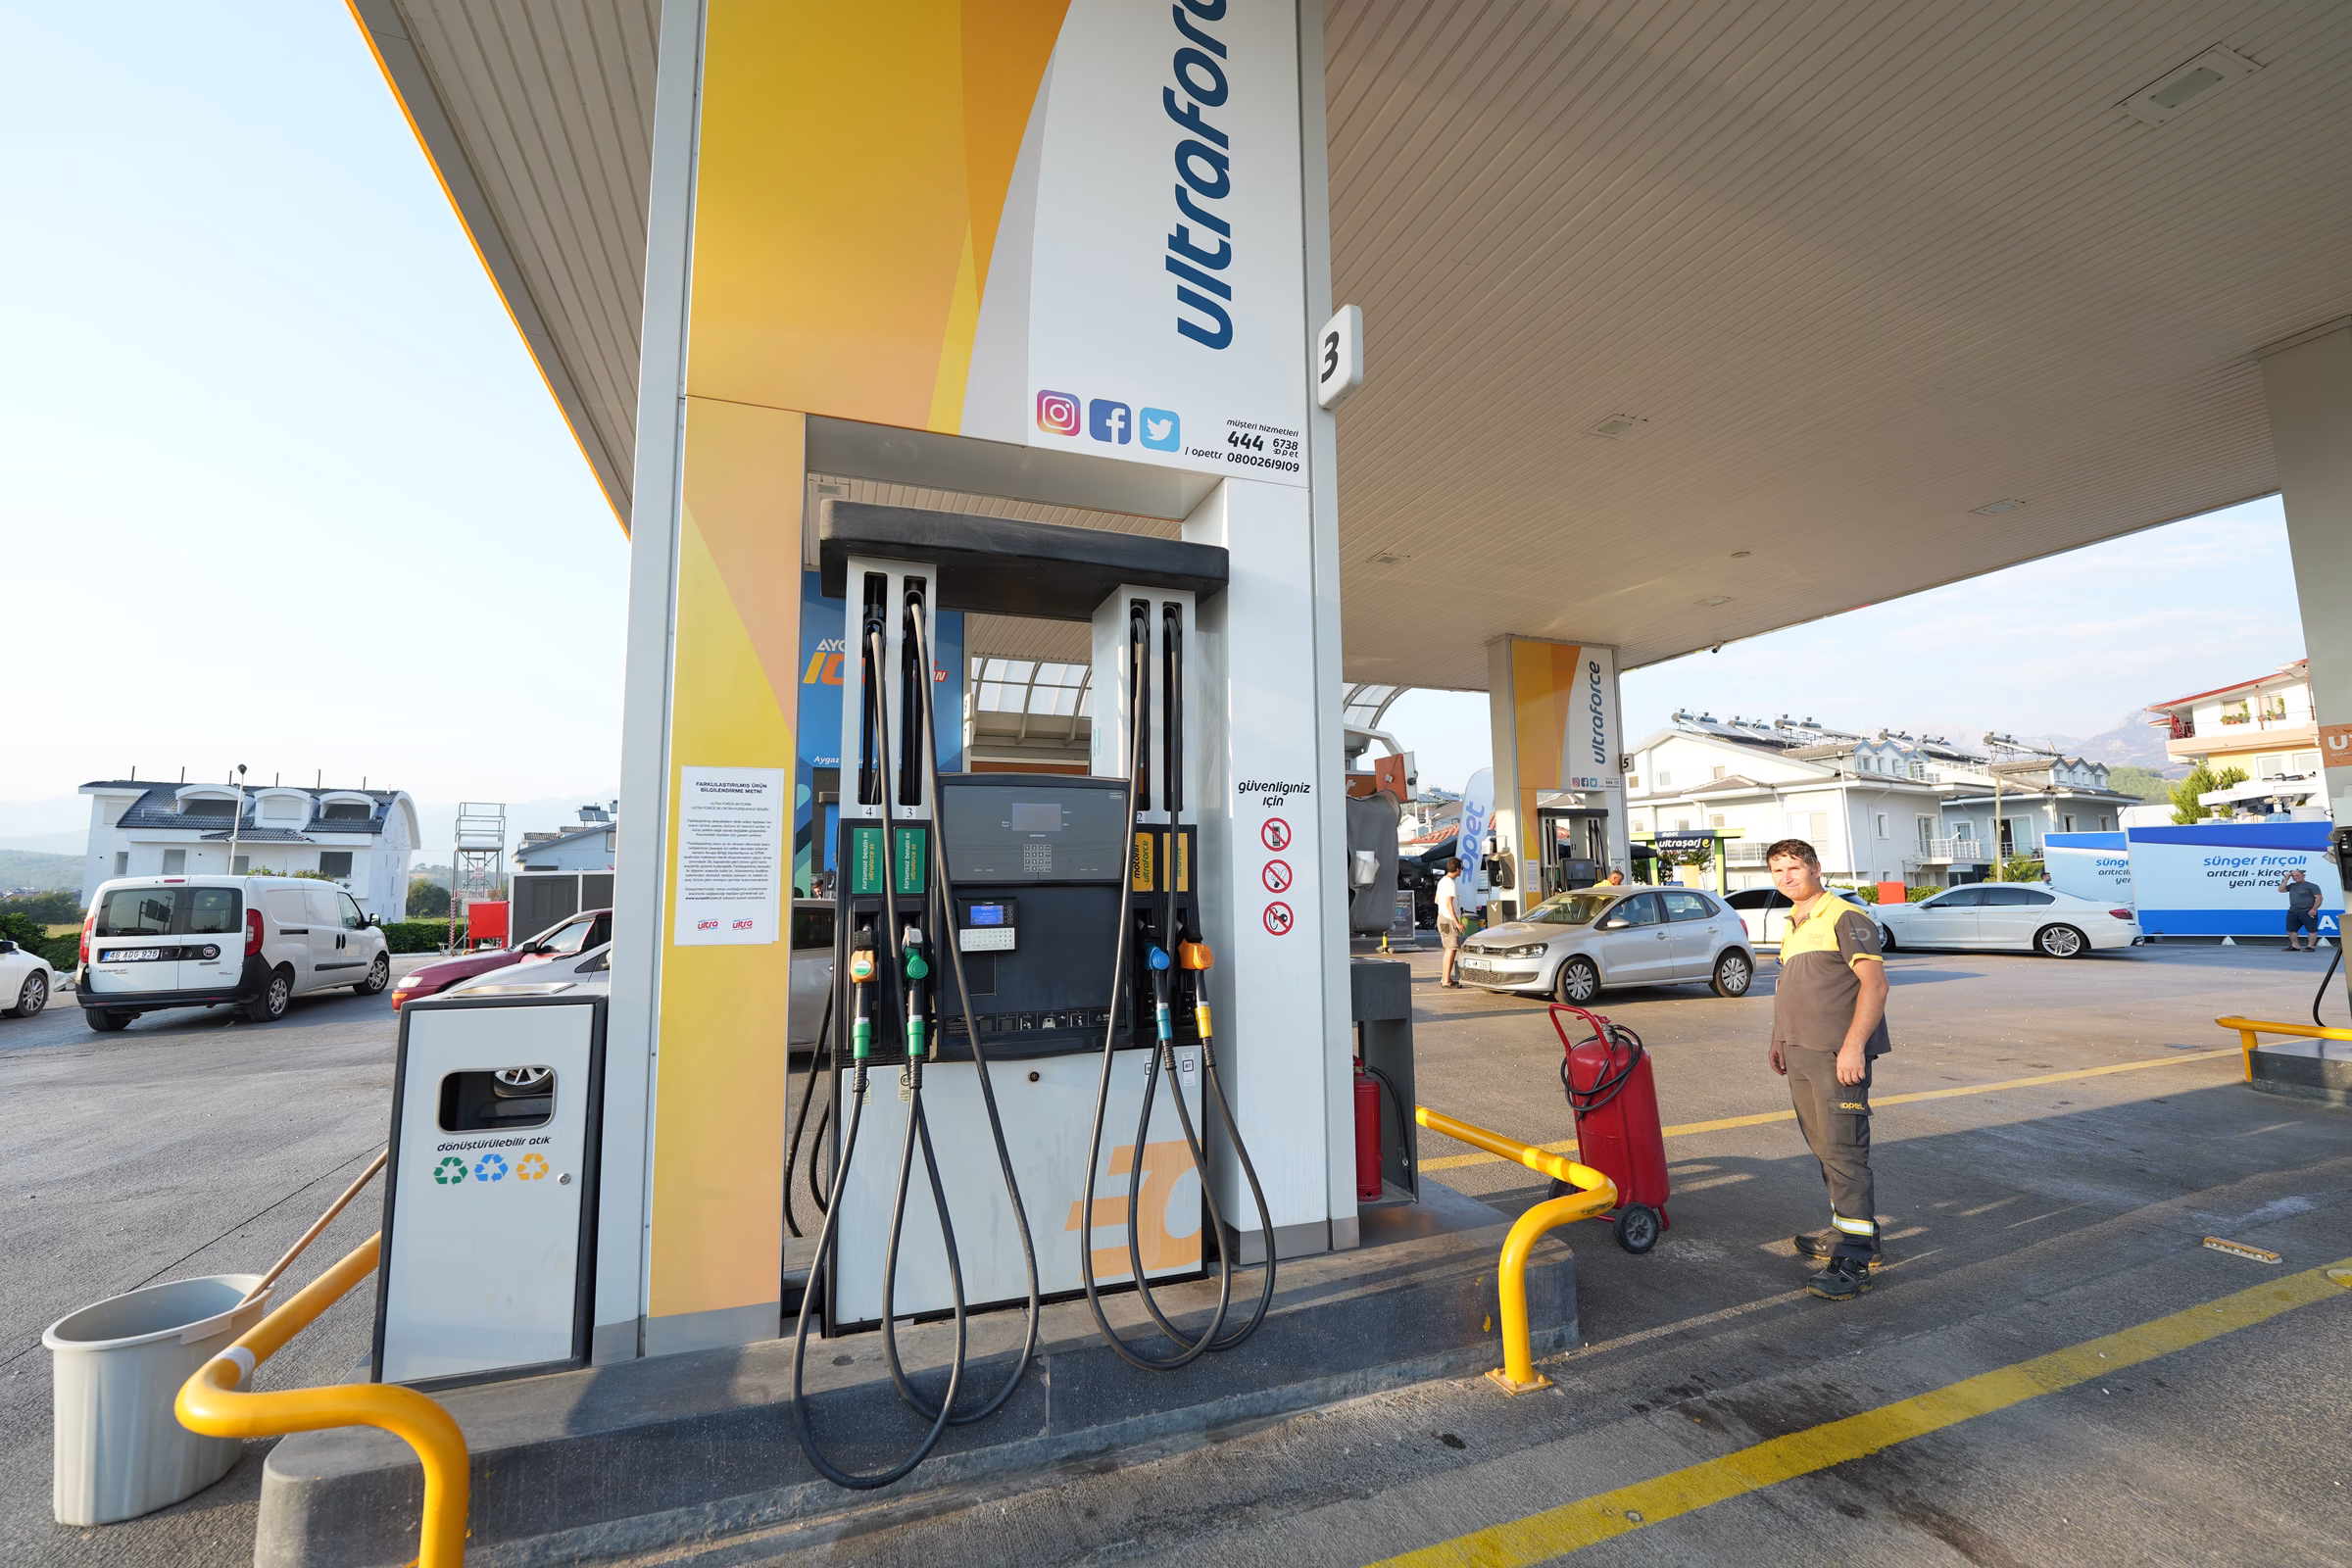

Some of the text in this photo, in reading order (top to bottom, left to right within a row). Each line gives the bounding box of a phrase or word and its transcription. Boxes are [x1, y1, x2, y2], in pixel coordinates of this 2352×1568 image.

[1321, 330, 1340, 383] 3
[1226, 418, 1299, 437] müşteri hizmetleri
[1227, 430, 1298, 452] 444 6738
[1191, 448, 1223, 460] opettr
[1226, 452, 1300, 472] 08002619109
[1589, 661, 1606, 764] ultraforce
[813, 756, 840, 764] Aygaz
[1623, 758, 1629, 768] 5
[865, 807, 873, 817] 4
[906, 807, 913, 818] 3
[1136, 811, 1143, 822] 2
[1460, 800, 1486, 885] opet
[1658, 837, 1701, 849] ultraşarj
[2203, 855, 2307, 868] sünger fırçalı
[2206, 869, 2249, 878] arıtıcılı
[2229, 878, 2256, 889] yeni
[697, 920, 718, 930] ultra
[732, 919, 753, 929] ultra
[436, 1135, 552, 1152] dönüştürülebilir atık
